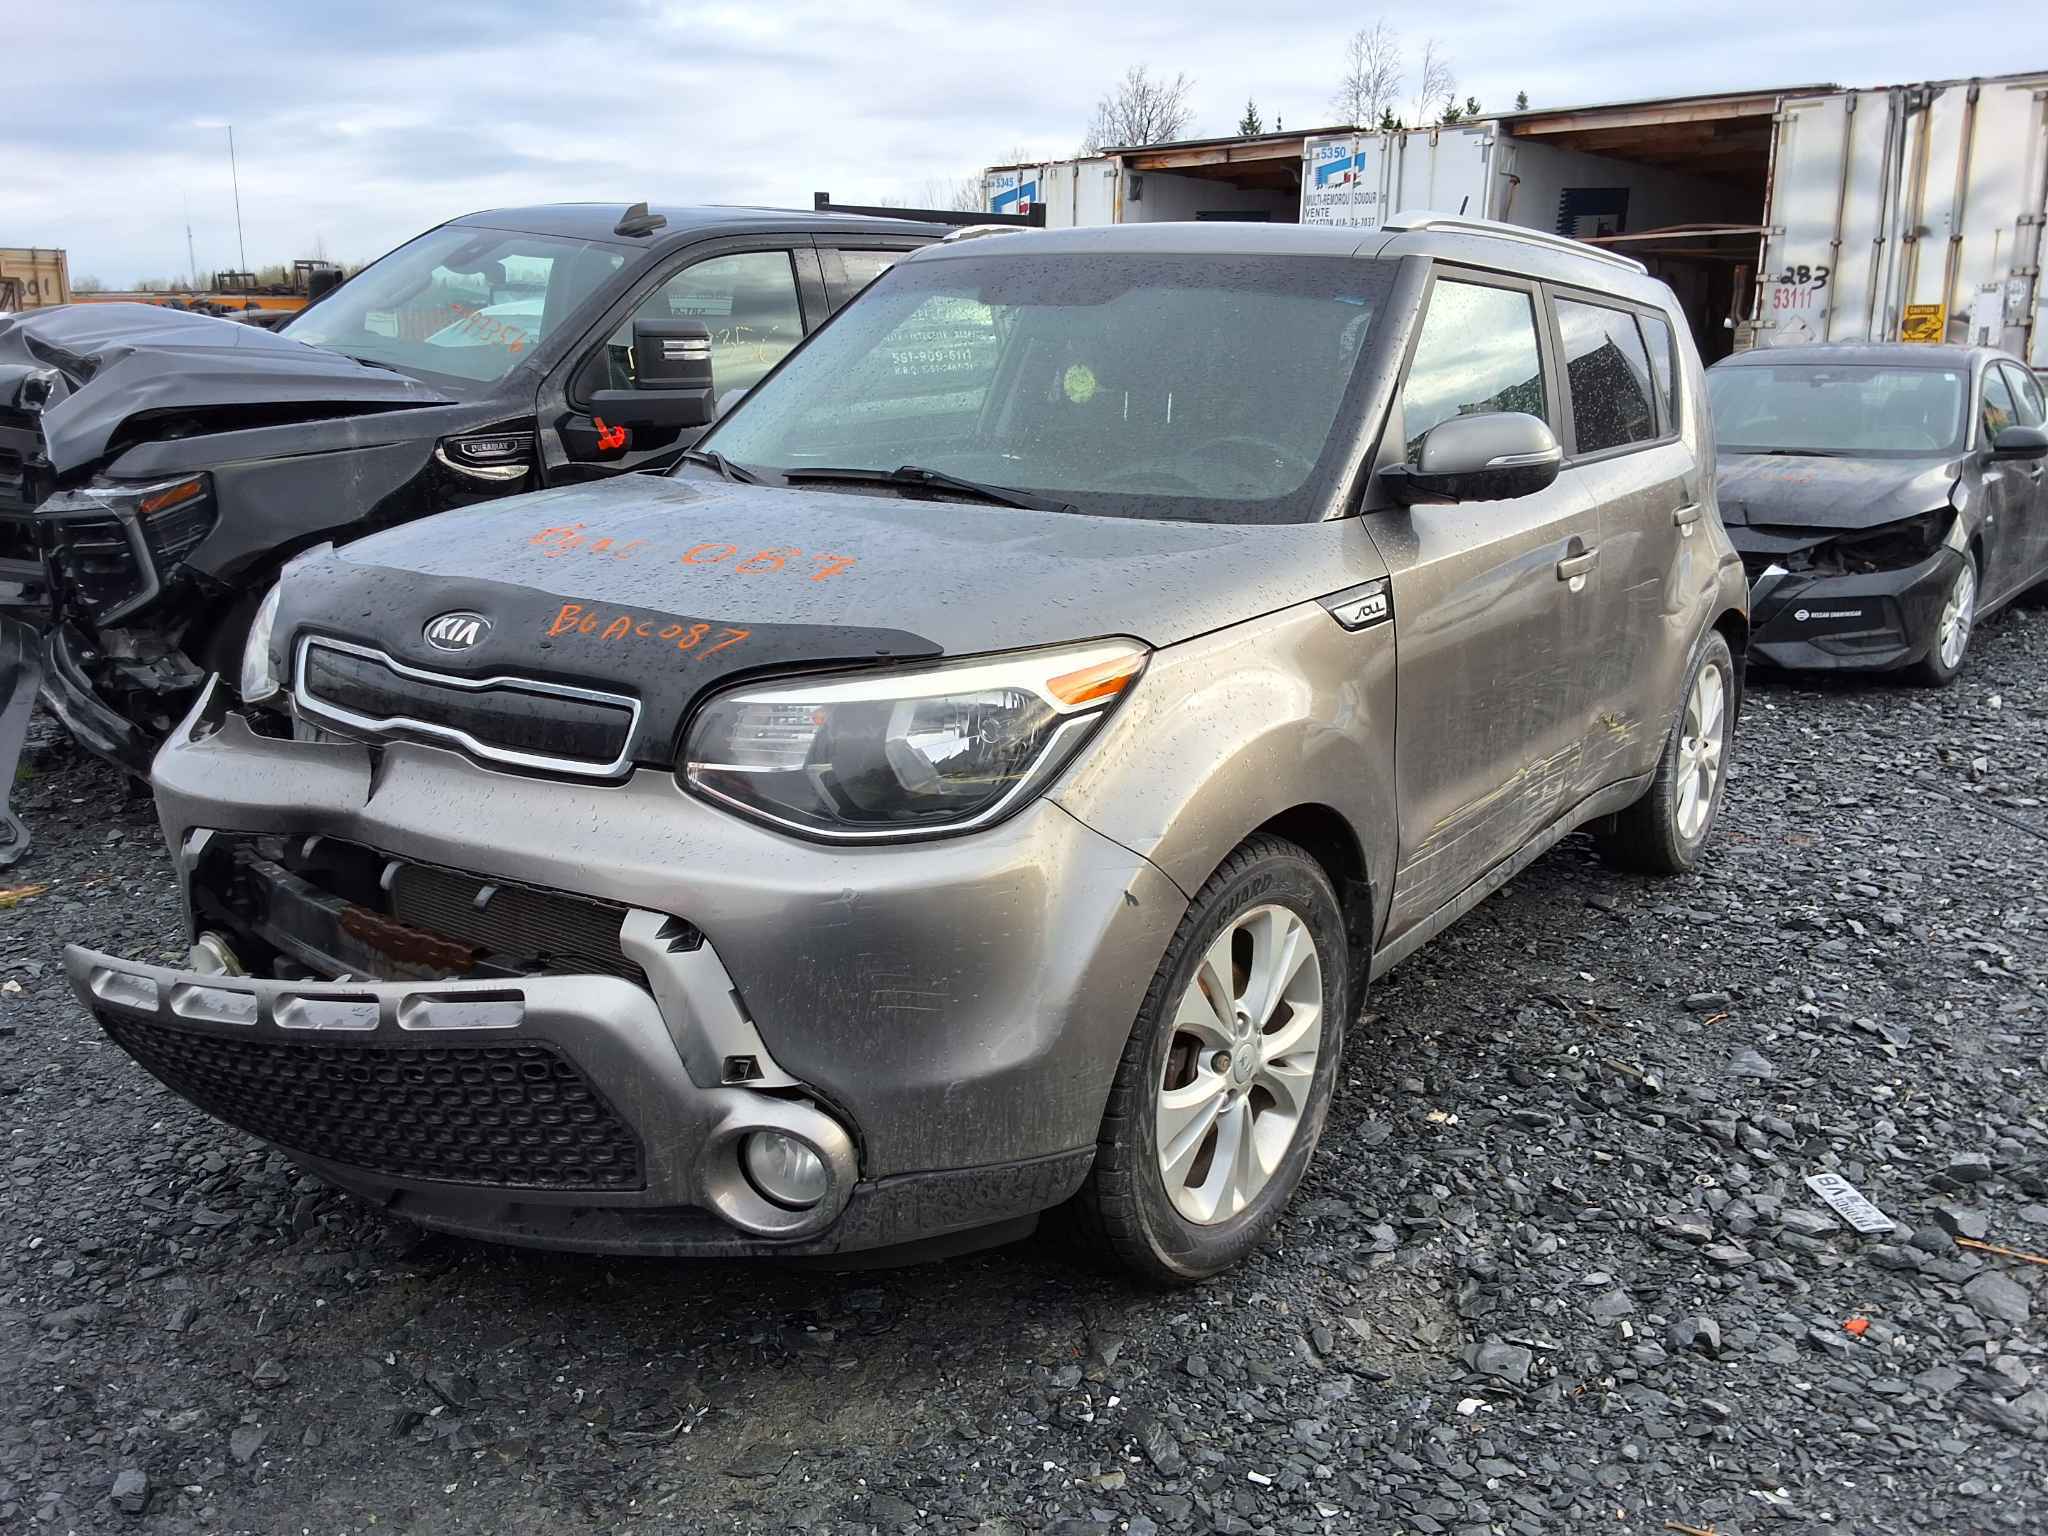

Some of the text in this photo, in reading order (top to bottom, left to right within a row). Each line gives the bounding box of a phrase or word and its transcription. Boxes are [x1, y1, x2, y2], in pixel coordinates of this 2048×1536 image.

[1321, 146, 1346, 160] 5350
[1305, 207, 1330, 218] VENTE
[1773, 286, 1813, 309] 53111
[1354, 601, 1386, 621] SOUL
[430, 616, 481, 646] KIA
